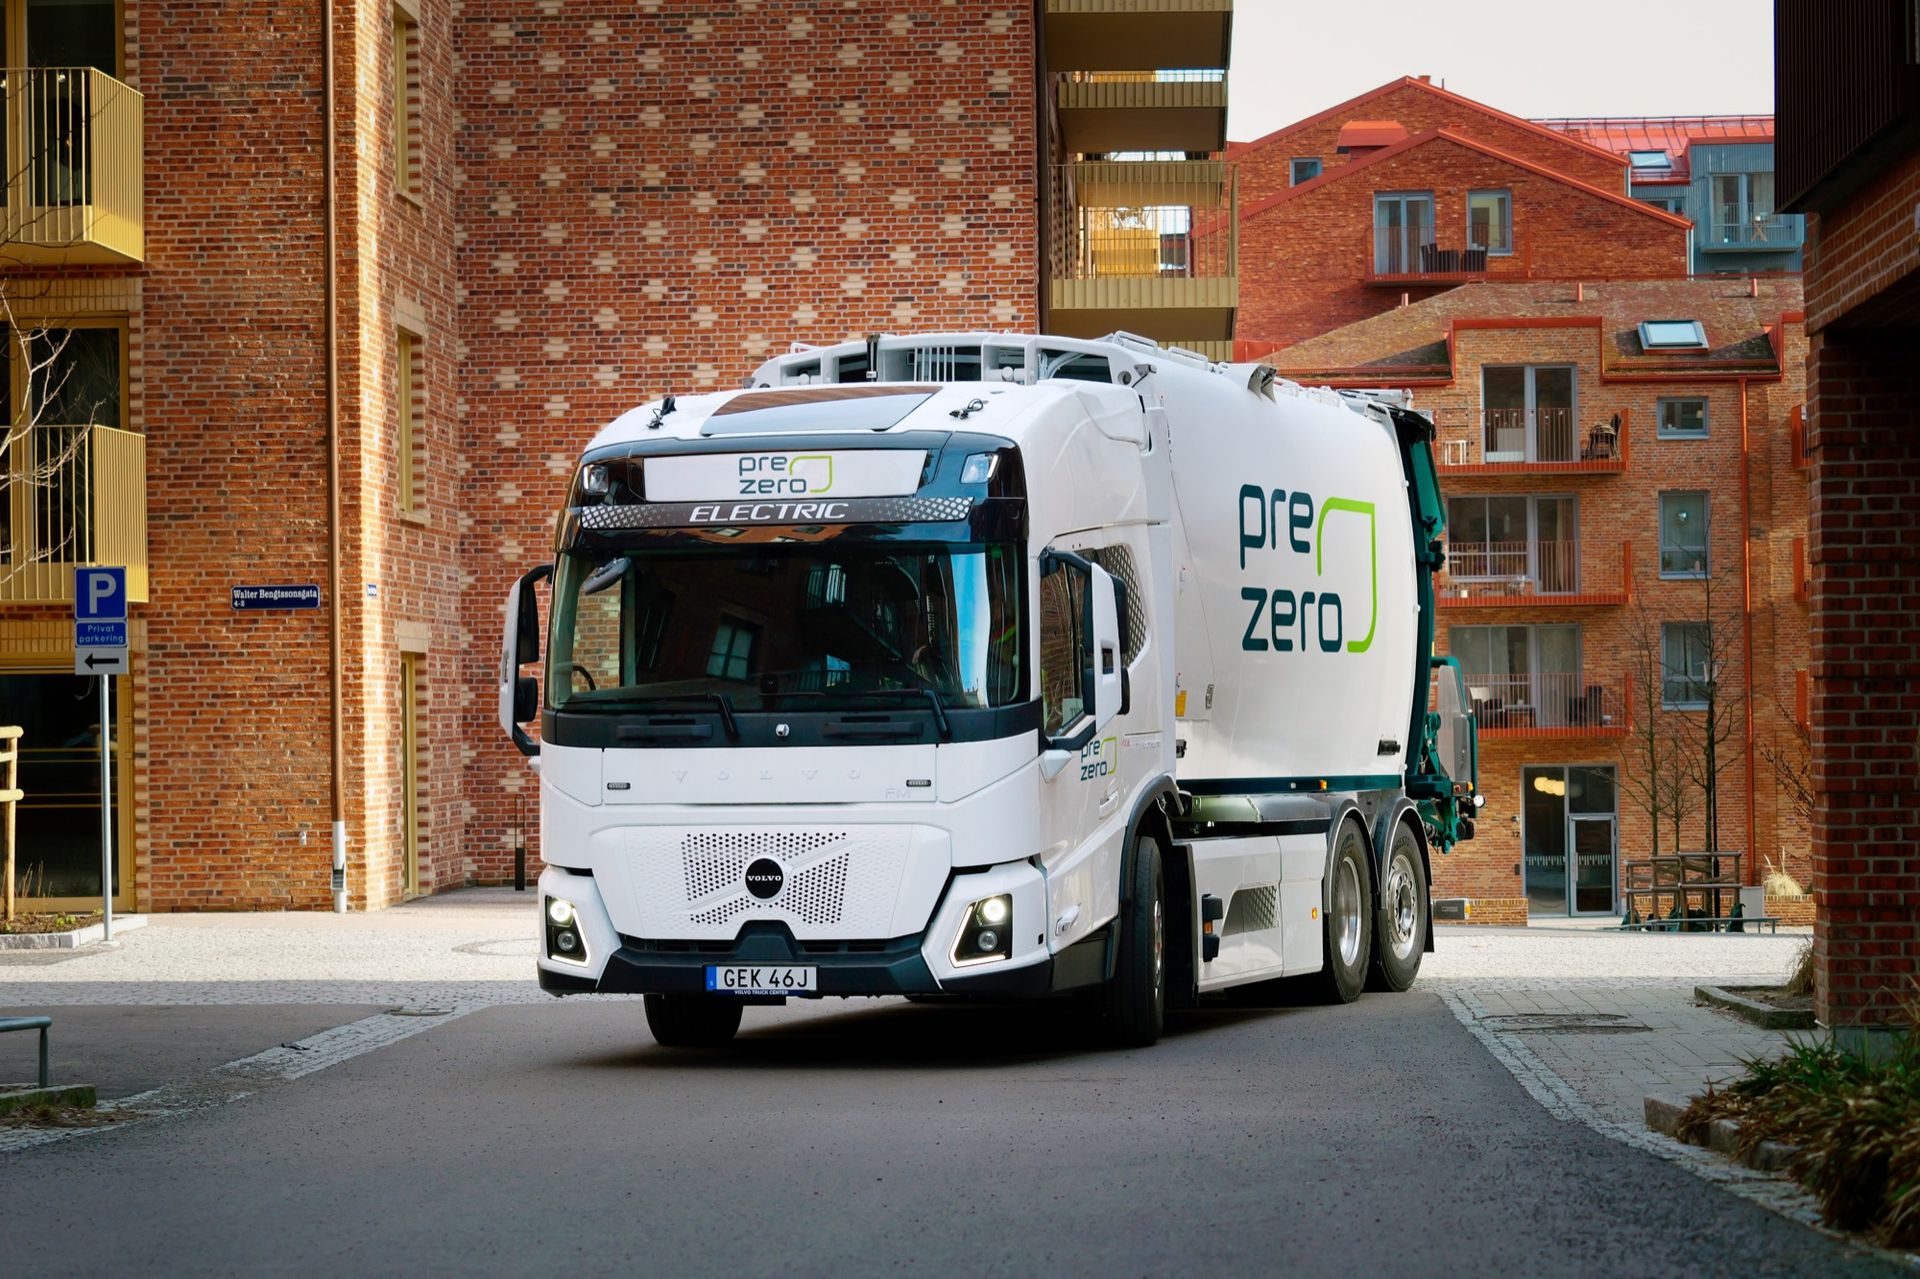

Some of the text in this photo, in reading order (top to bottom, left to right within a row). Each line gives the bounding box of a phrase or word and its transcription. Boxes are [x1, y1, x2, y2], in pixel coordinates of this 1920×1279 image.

[739, 456, 788, 476] pre
[739, 478, 807, 494] zero
[689, 502, 849, 522] ELECTRIC
[1239, 484, 1314, 570] pre
[89, 573, 117, 614] P
[233, 589, 318, 600] Walter Bengtssonsgata
[88, 624, 114, 633] Privat
[1241, 587, 1343, 653] zero
[79, 634, 124, 644] parkering
[672, 769, 862, 783] VOLVO
[1080, 761, 1108, 781] zero
[885, 787, 911, 800] FM
[724, 969, 808, 988] GEK 46J
